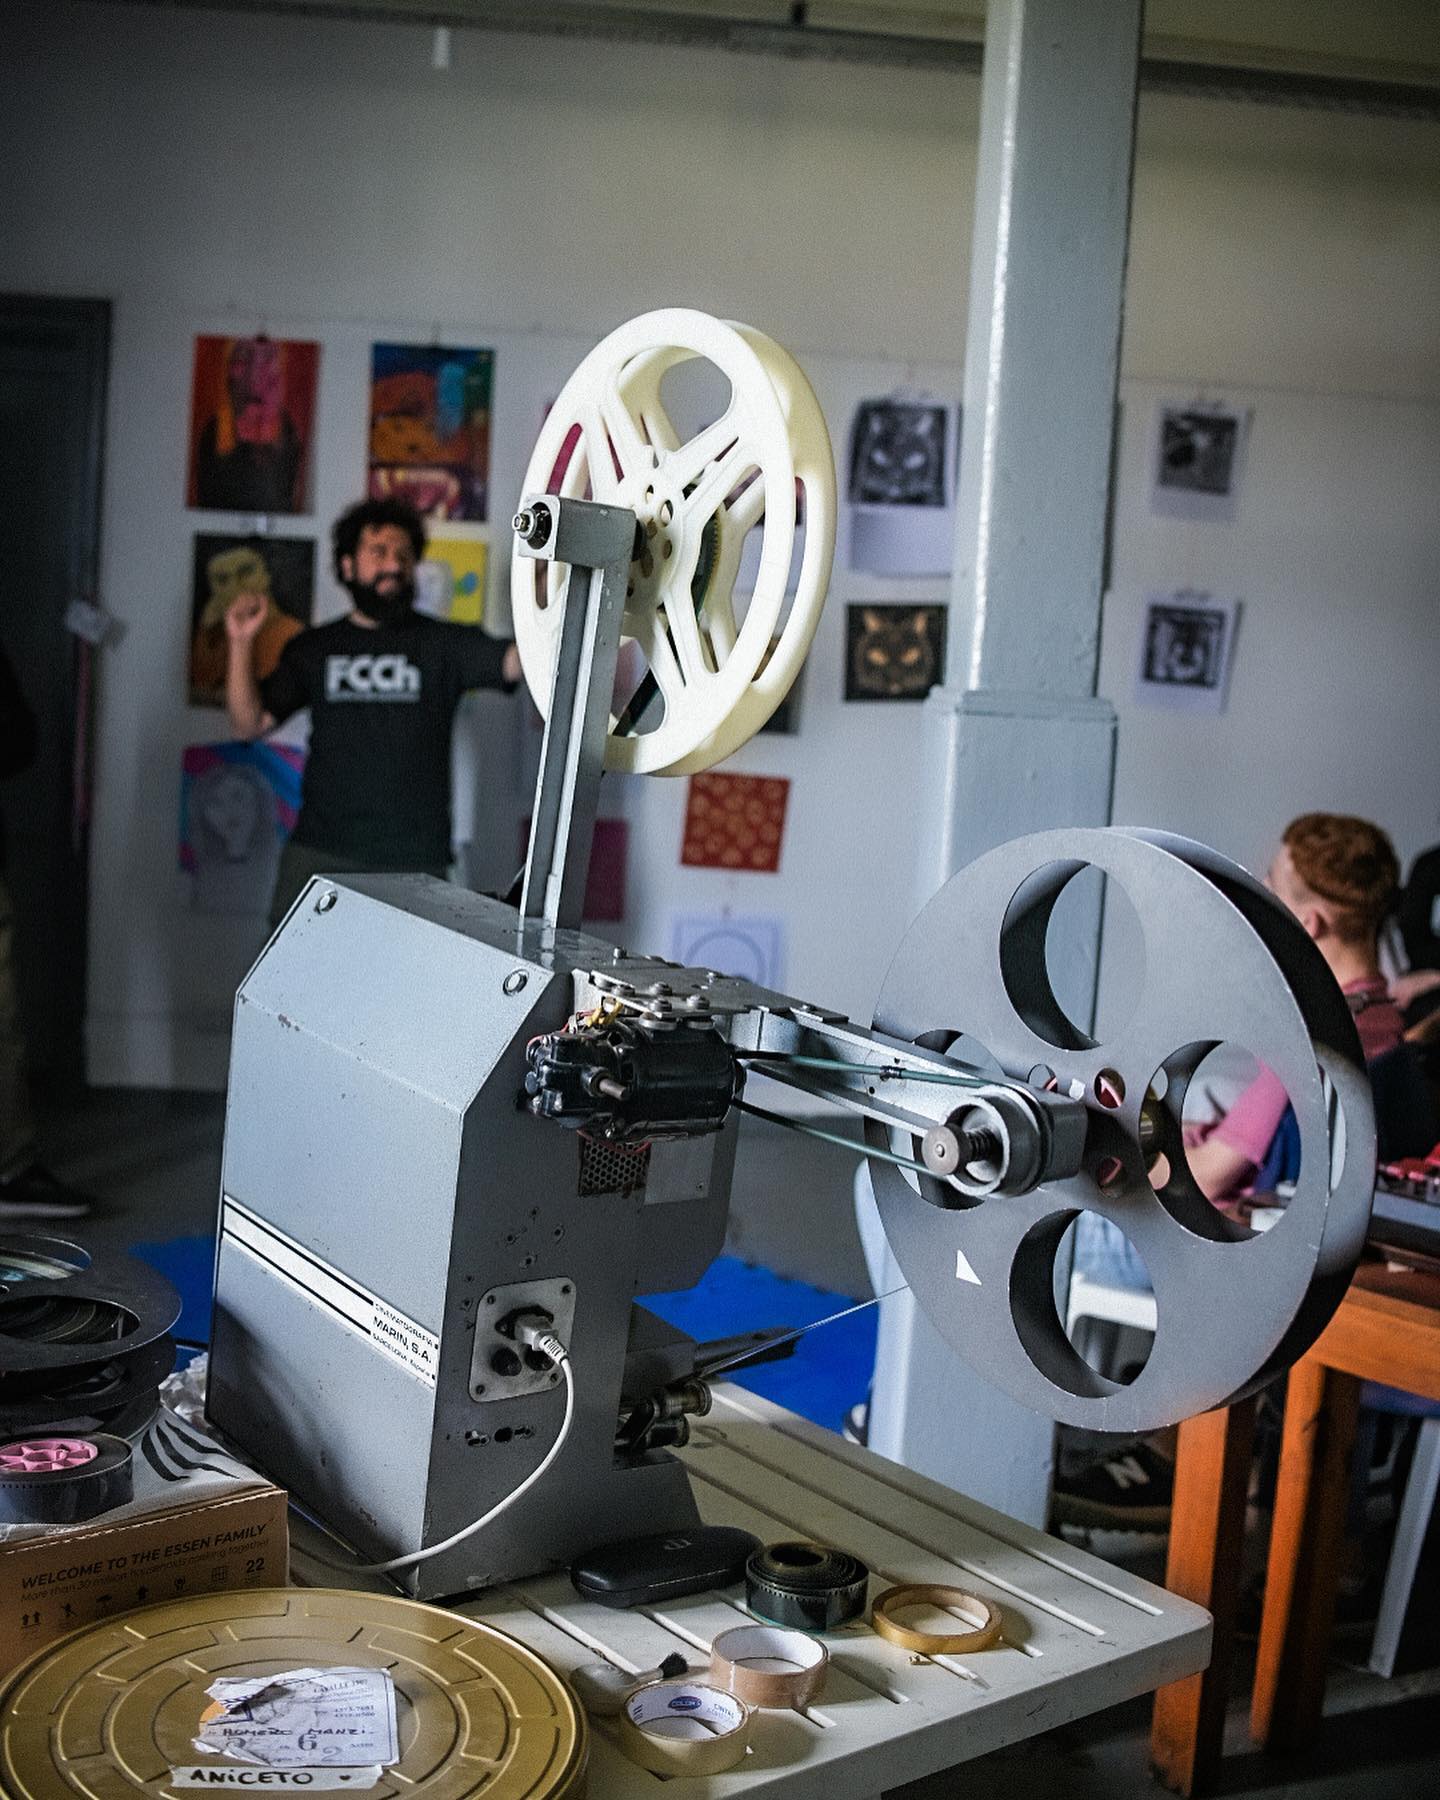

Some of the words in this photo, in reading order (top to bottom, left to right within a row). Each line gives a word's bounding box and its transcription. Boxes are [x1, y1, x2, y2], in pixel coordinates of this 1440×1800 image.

[373, 1315, 409, 1351] MARIN,
[411, 1341, 432, 1364] S.A.
[21, 1560, 102, 1590] WELCOME
[108, 1556, 128, 1571] TO
[131, 1548, 161, 1565] THE
[164, 1536, 211, 1558] ESSEN
[214, 1523, 268, 1547] FAMILY
[246, 1557, 266, 1574] 22
[222, 1727, 293, 1737] HOMERO
[298, 1733, 318, 1751] 6
